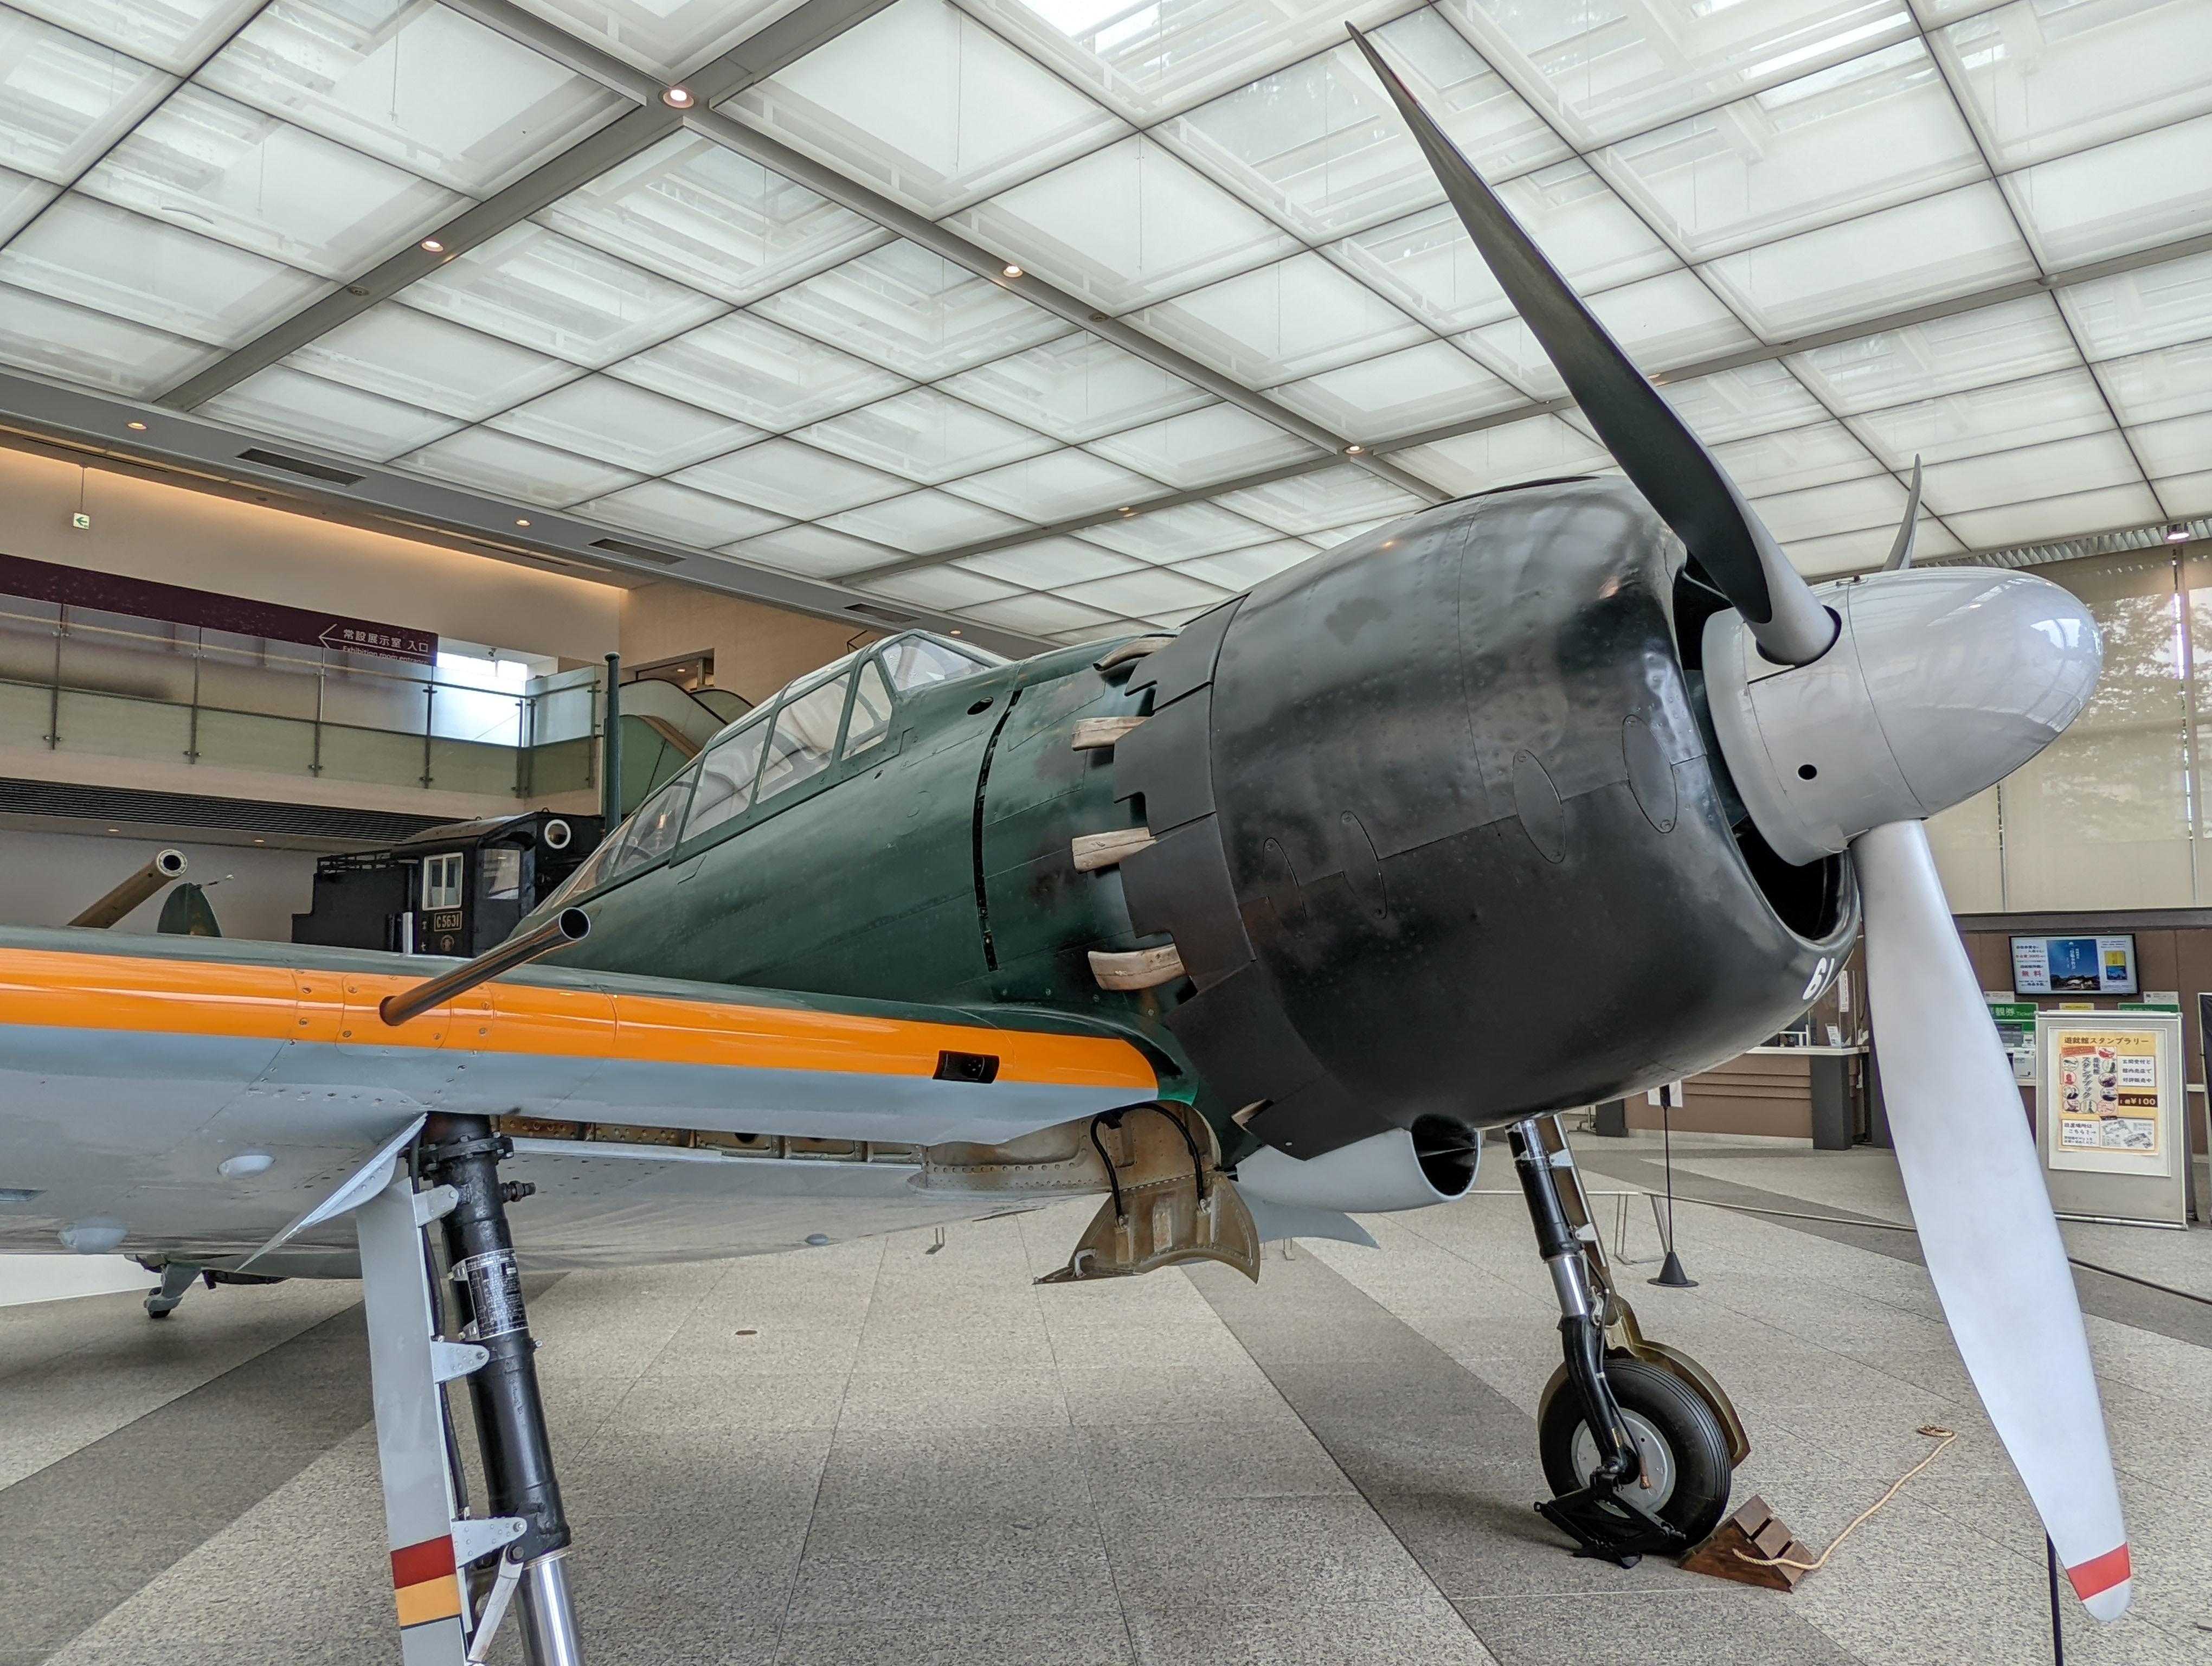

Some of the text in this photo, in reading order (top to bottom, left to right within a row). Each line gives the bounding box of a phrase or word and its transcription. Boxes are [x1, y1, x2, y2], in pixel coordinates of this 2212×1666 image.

[343, 629, 429, 653] 常設展示室 入口
[343, 645, 378, 658] Exhibition
[379, 652, 397, 661] room
[436, 913, 459, 928] C5631
[2064, 1036, 2149, 1045] 遊就館スタンプラリー
